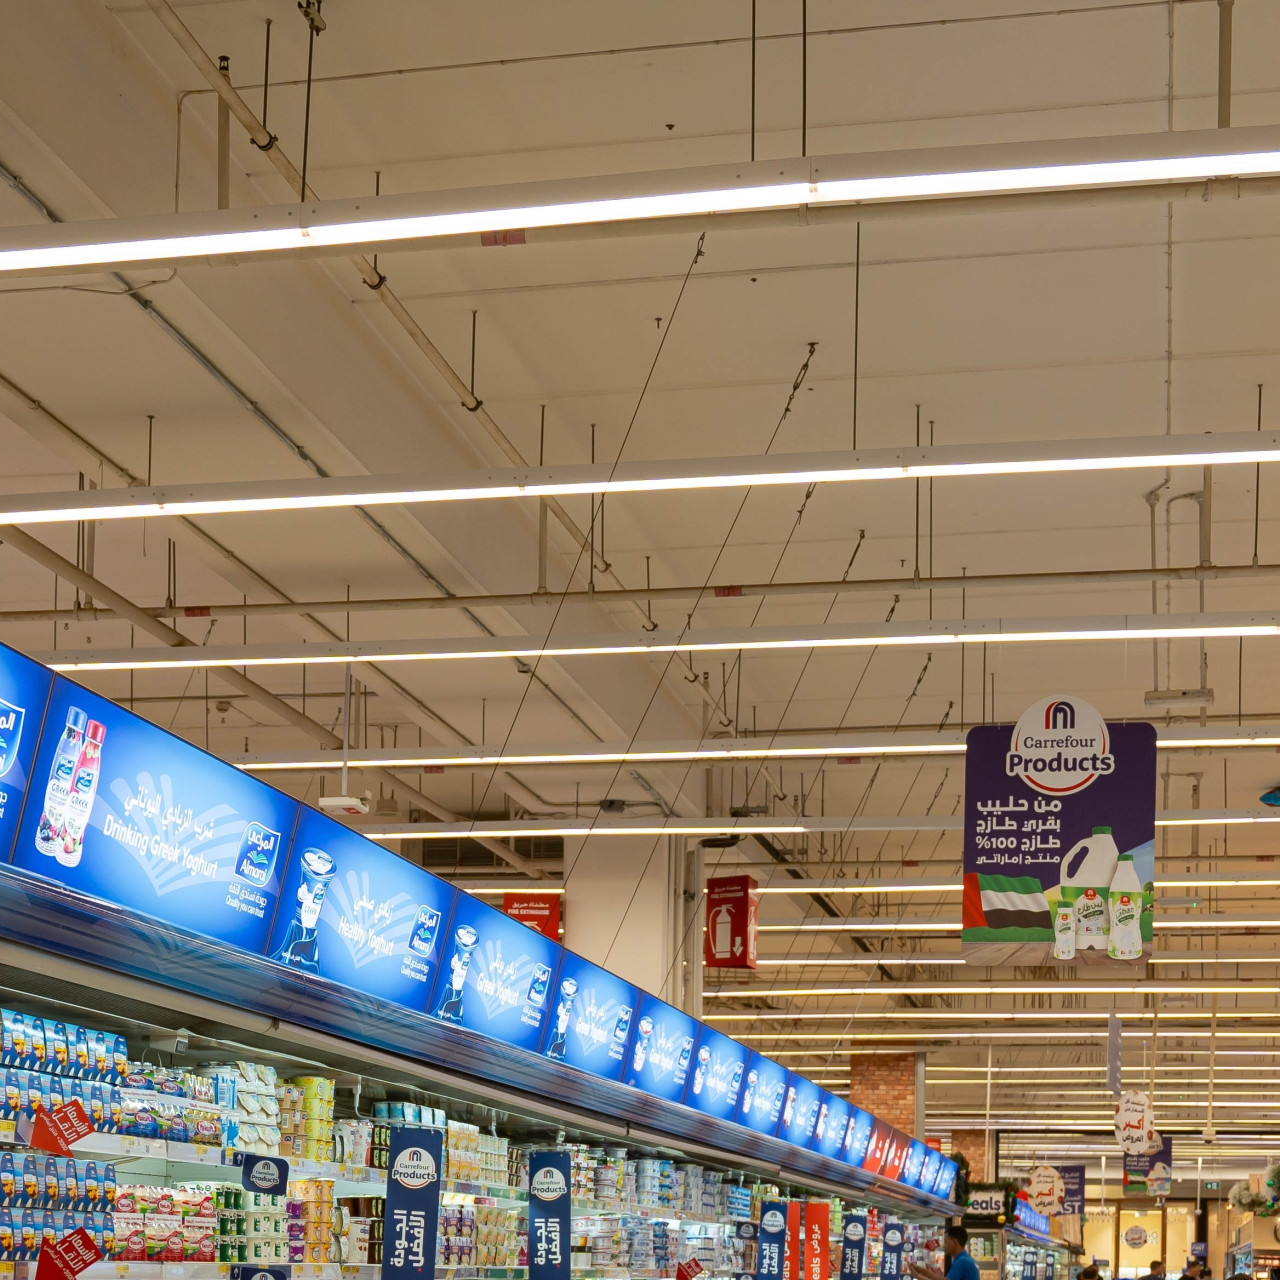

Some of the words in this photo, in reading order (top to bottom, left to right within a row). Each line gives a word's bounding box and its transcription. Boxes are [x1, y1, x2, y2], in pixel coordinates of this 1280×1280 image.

[1023, 735, 1096, 749] Carrefour
[1009, 752, 1112, 773] Products
[124, 787, 161, 815] اليوناني
[977, 796, 1028, 815] حليب
[1033, 797, 1062, 813] من
[161, 803, 192, 834] الزبادي
[976, 817, 1017, 834] طازج
[1022, 818, 1061, 833] بقري
[193, 819, 215, 840] شرب
[103, 814, 149, 853] Drinking
[150, 835, 181, 863] Greek
[181, 848, 219, 879] Yoghurt
[247, 829, 275, 852] المراعي
[1022, 836, 1061, 851] طازج
[976, 853, 1022, 865] إماراتي
[1025, 854, 1061, 864] منتج
[240, 859, 268, 882] Almarai
[339, 915, 366, 947] Healthy
[367, 930, 395, 956] Yoghurt
[51, 1111, 78, 1142] الأقل
[66, 1101, 90, 1136] الأسعار
[1123, 1115, 1145, 1131] أكبر
[251, 1175, 278, 1183] Products
[393, 1170, 436, 1180] Products
[531, 1186, 566, 1194] Products
[71, 1230, 97, 1266] الأسعار
[390, 1210, 408, 1267] الجودة
[534, 1219, 547, 1265] الجودة
[811, 1224, 822, 1254] عروض
[56, 1239, 85, 1272] الأقل
